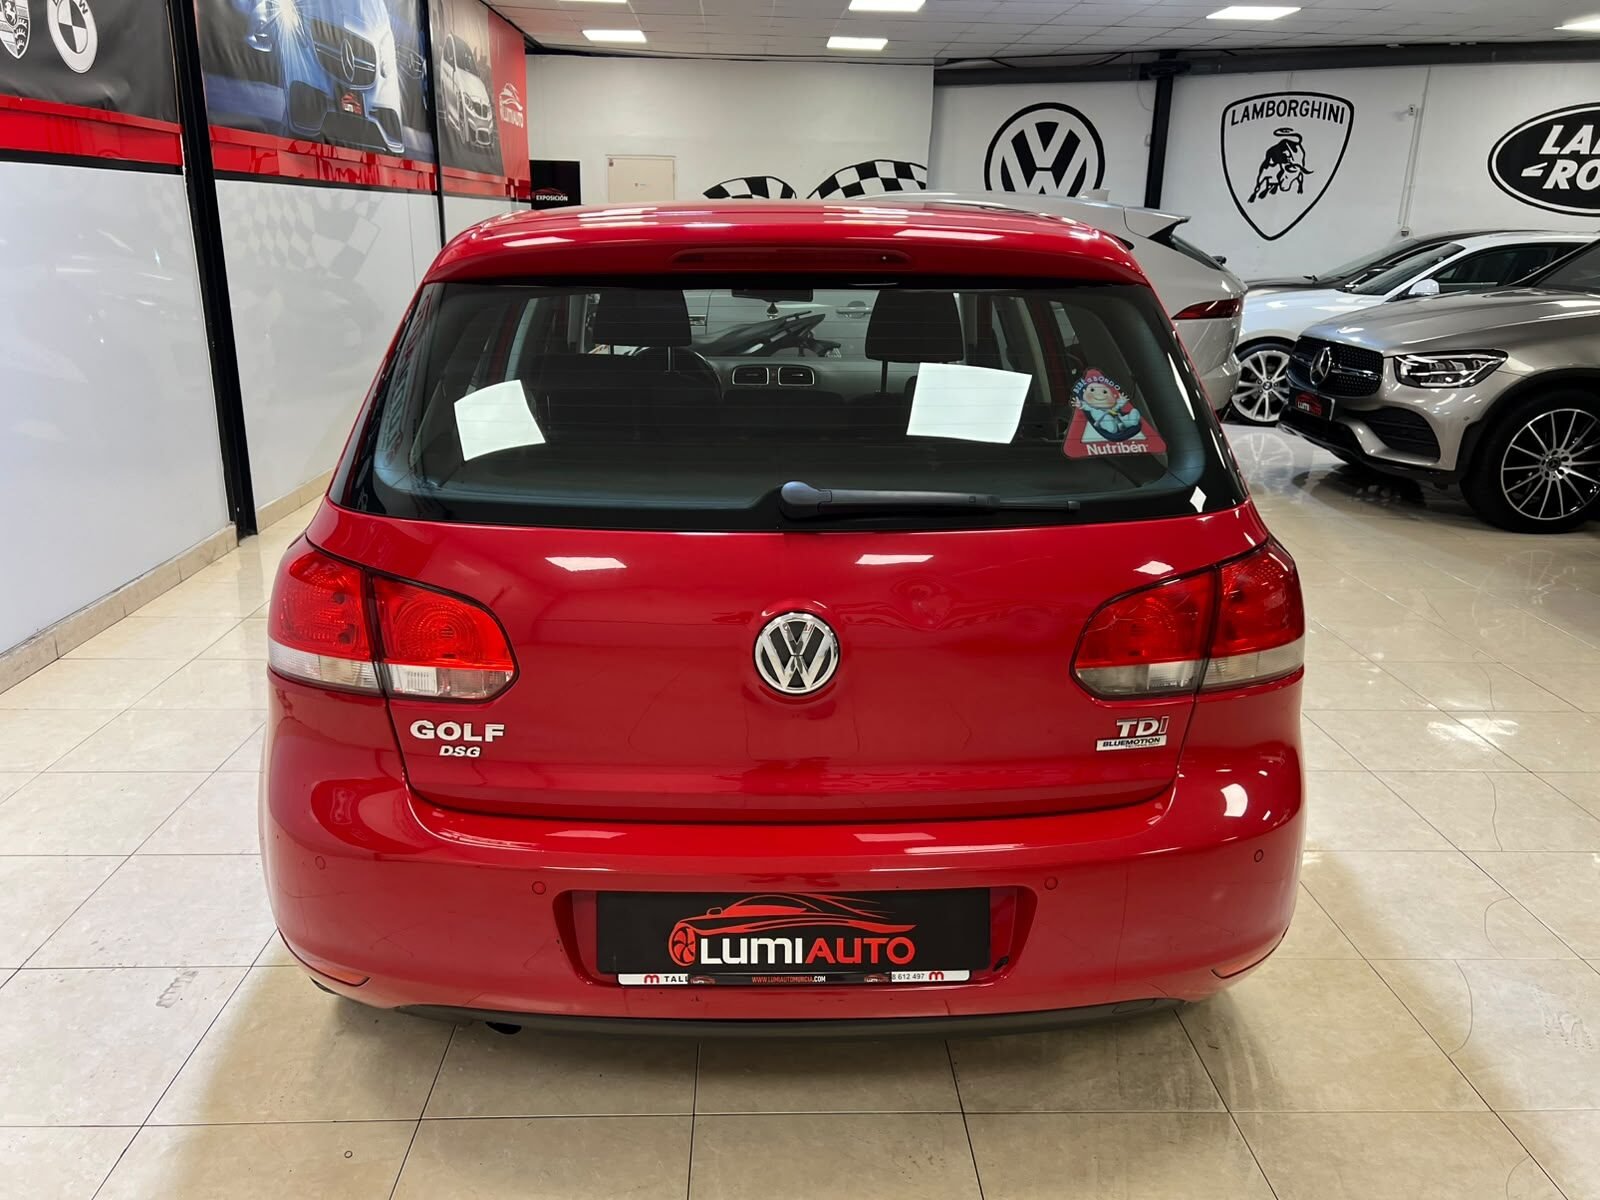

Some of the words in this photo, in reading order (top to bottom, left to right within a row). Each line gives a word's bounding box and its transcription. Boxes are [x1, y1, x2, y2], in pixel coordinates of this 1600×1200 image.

[1230, 99, 1345, 126] LAMBORGHINI
[1539, 124, 1600, 155] LA
[536, 193, 568, 202] EXPOSICIÓN
[1093, 376, 1121, 391] BORDO
[1086, 441, 1147, 456] Nutribén
[410, 720, 505, 743] GOLF
[1116, 716, 1170, 738] TDI
[439, 745, 480, 758] DSG
[1102, 737, 1161, 748] BLUEMOTION
[700, 937, 916, 965] LUMIAUTO
